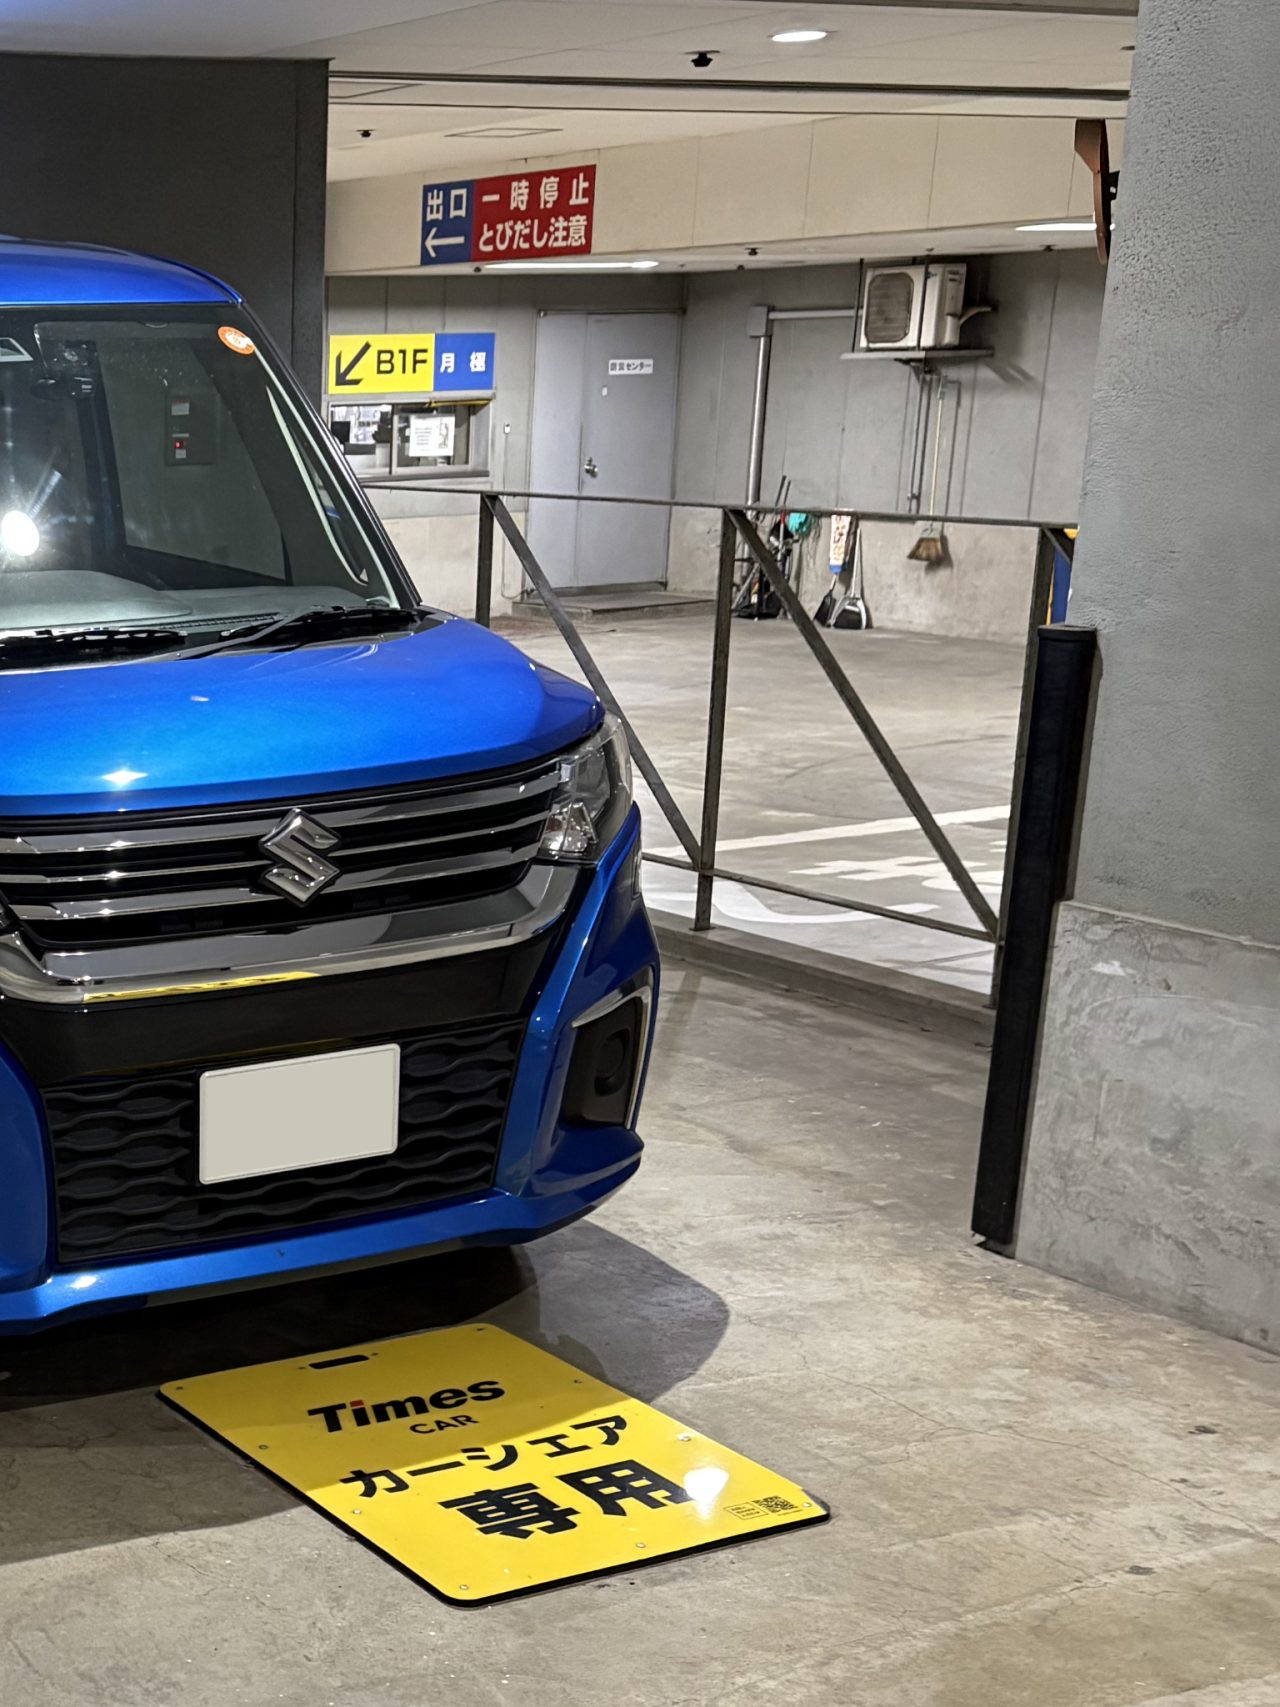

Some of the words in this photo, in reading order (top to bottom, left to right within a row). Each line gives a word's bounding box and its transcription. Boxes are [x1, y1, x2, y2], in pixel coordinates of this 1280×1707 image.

[426, 187, 467, 222] 出口
[481, 172, 589, 211] 一時停止
[478, 214, 587, 252] とびだし注意
[376, 348, 428, 374] B1F
[307, 1380, 505, 1433] Times
[409, 1414, 479, 1434] CAR
[339, 1415, 627, 1498] カーシェア
[438, 1459, 695, 1539] 専用
